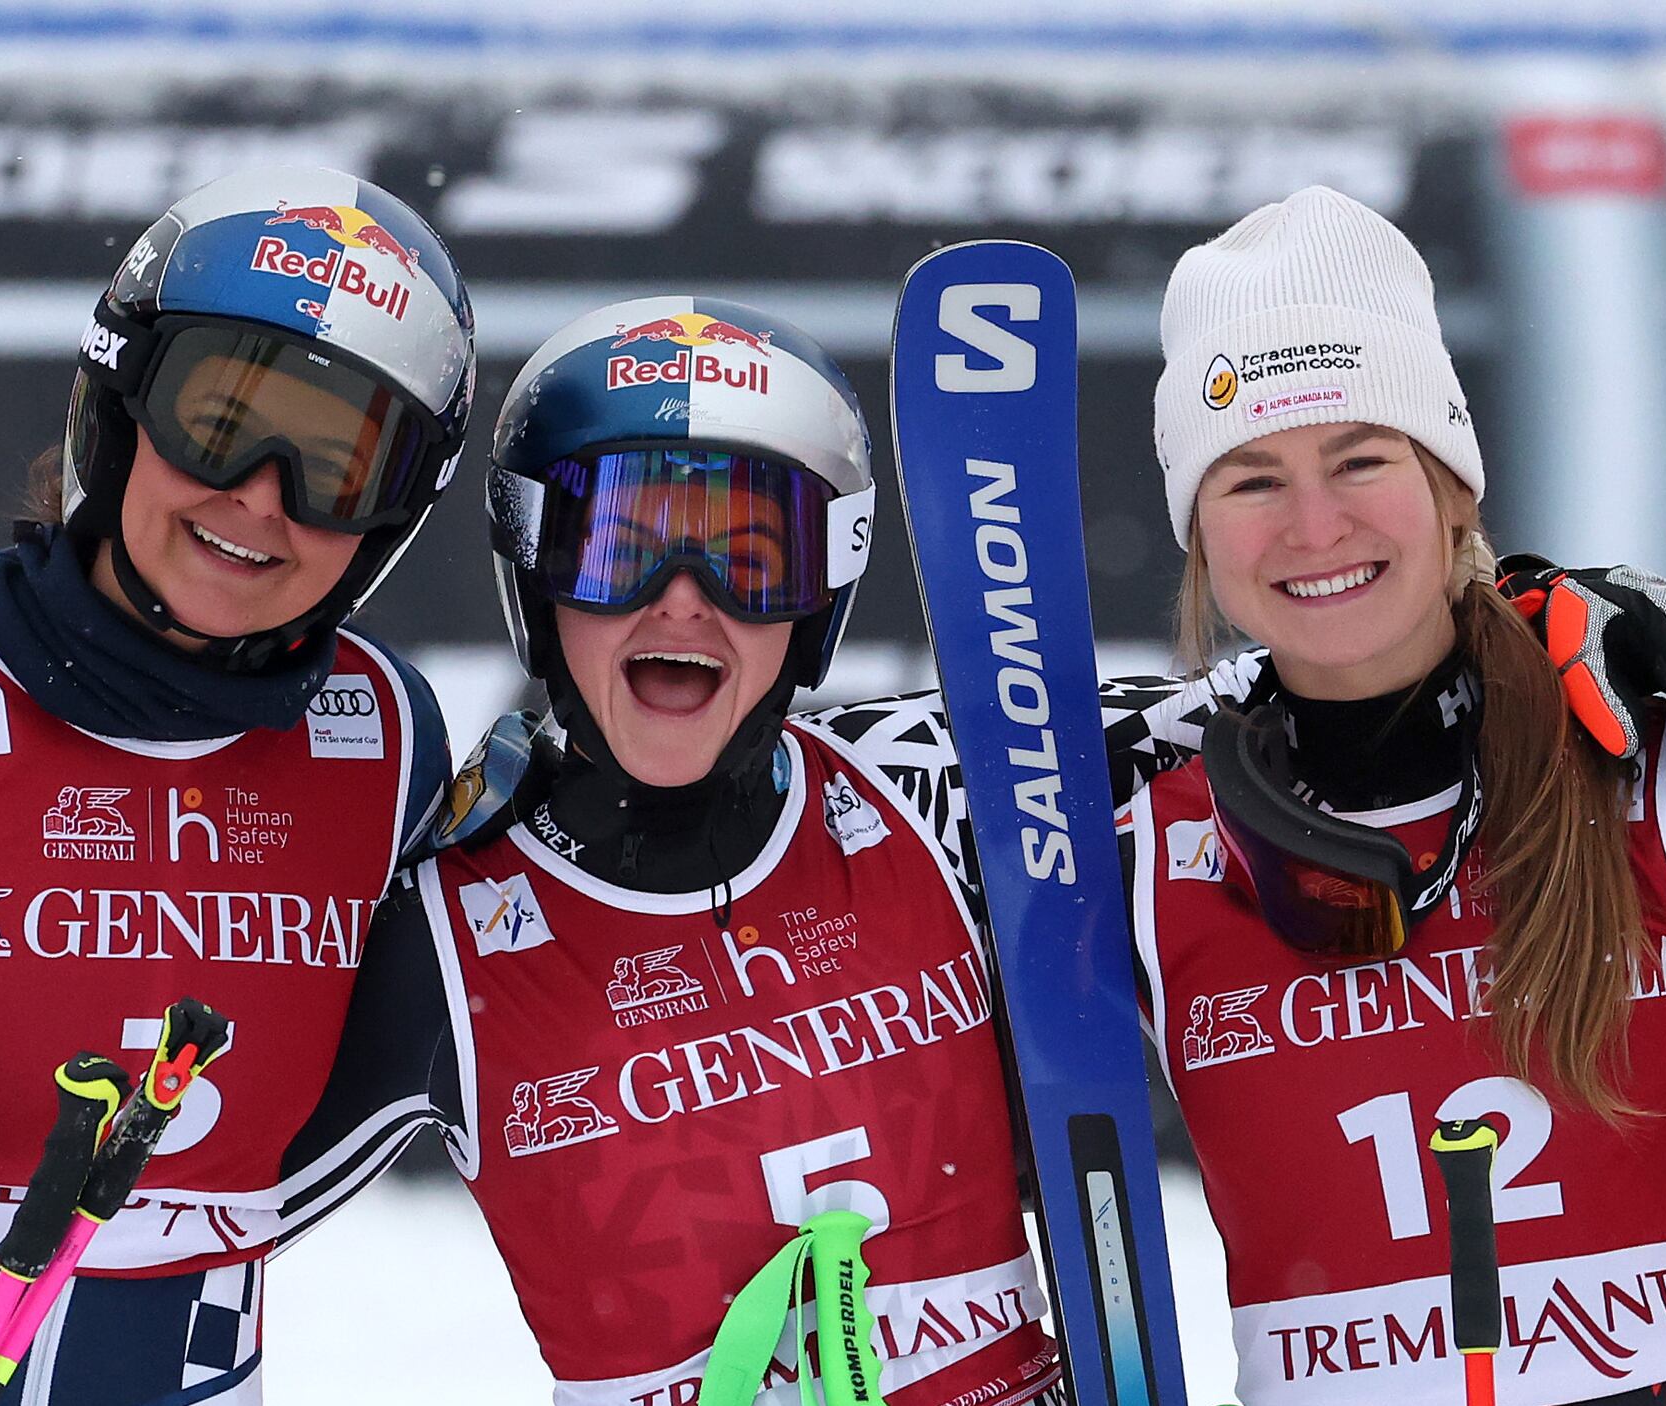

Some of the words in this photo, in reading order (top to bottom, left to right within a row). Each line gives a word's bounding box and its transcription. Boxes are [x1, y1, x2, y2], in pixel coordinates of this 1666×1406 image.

[252, 237, 339, 285] Red
[337, 259, 411, 321] Bull
[307, 351, 331, 367] uvex
[610, 352, 687, 390] Red
[694, 355, 768, 395] Bull
[1267, 360, 1308, 377] mon
[1269, 396, 1292, 410] ALPINE
[1293, 391, 1322, 405] CANADA
[1323, 390, 1343, 401] ALPIN
[964, 458, 1077, 886] SALOMON
[225, 787, 259, 807] The
[226, 808, 294, 827] Human
[43, 843, 135, 862] GENERALI
[227, 828, 289, 849] Safety
[228, 848, 265, 864] Net
[779, 905, 818, 925] The
[785, 910, 858, 947] Human
[793, 931, 859, 964] Safety
[802, 955, 842, 980] Net
[614, 993, 710, 1030] GENERALI
[1336, 1076, 1565, 1241] 12
[759, 1125, 890, 1244] 5
[1102, 1221, 1121, 1304] BLADE
[840, 1257, 870, 1403] KOMPERDELL
